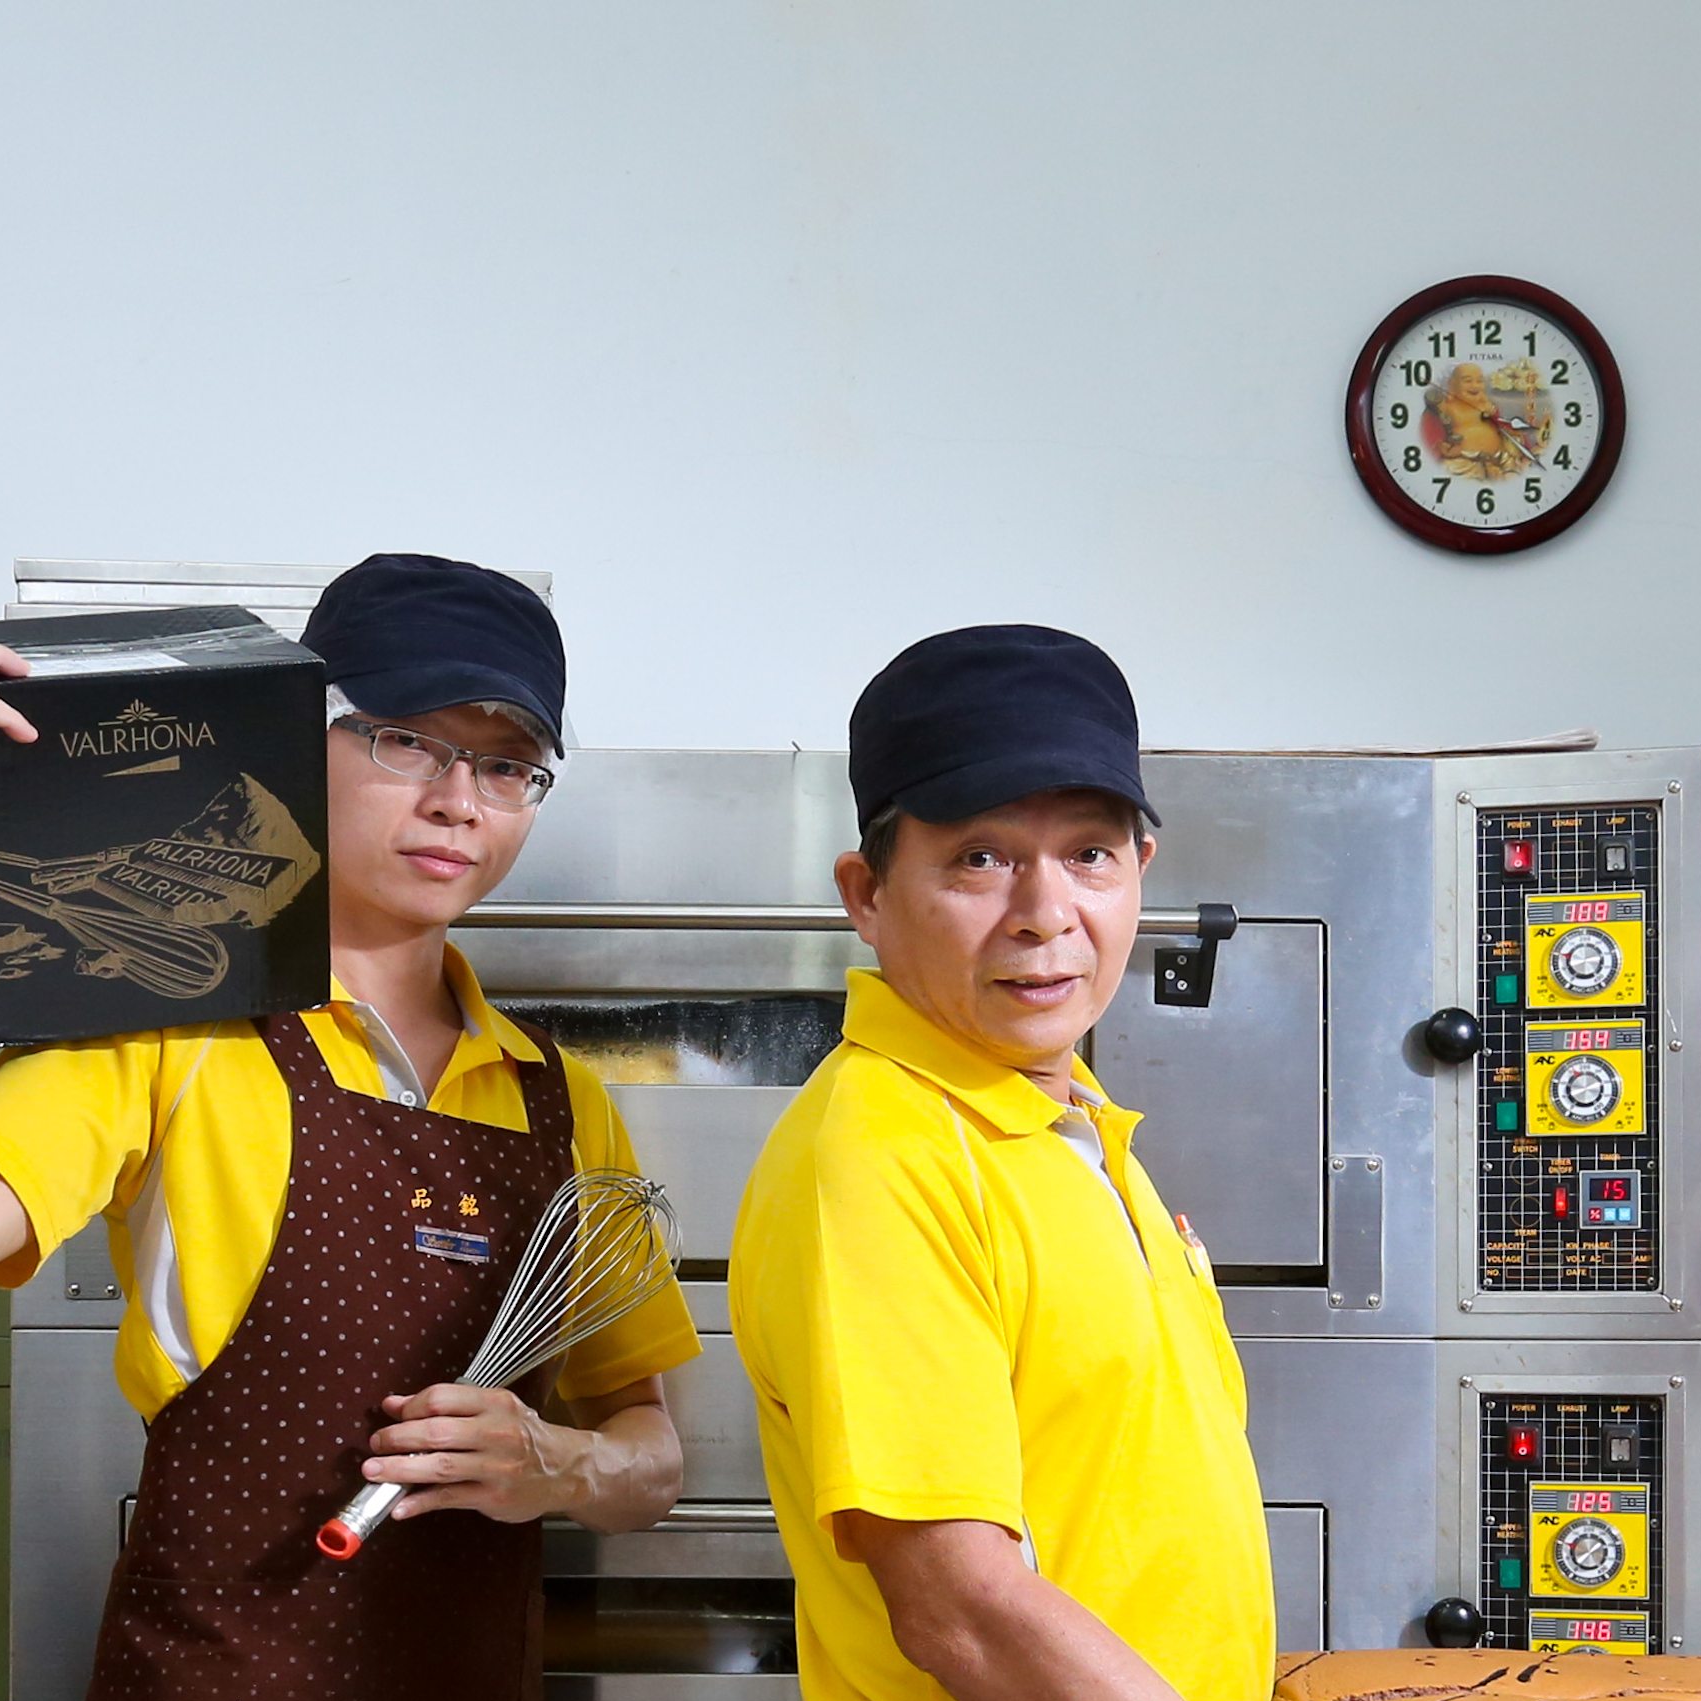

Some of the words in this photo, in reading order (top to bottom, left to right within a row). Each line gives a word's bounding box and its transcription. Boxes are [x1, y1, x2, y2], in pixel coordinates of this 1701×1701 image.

[1428, 332, 1456, 357] 11
[1470, 320, 1502, 345] 12
[1524, 332, 1536, 356] 1
[1400, 360, 1432, 386] 10
[1551, 360, 1569, 385] 2
[1390, 403, 1408, 429] 9
[1564, 402, 1581, 427] 3
[1403, 446, 1422, 472] 8
[1553, 445, 1571, 470] 4
[1432, 478, 1451, 503] 7
[1476, 489, 1495, 514] 6
[1524, 478, 1541, 503] 5
[60, 722, 215, 758] VALRHONA
[1552, 818, 1582, 827] EXHAUST
[1606, 817, 1626, 825] LAMP
[143, 841, 273, 885] VALRHONA
[112, 865, 214, 904] VALRHO
[1569, 901, 1609, 922] 109
[1534, 928, 1556, 937] ANC
[1569, 1029, 1610, 1050] 154
[1534, 1056, 1556, 1065] ANC
[1603, 1180, 1626, 1200] 15
[1487, 1242, 1525, 1250] CAPACITY
[1557, 1404, 1587, 1412] EXHAUST
[1572, 1492, 1613, 1513] 125
[1539, 1516, 1560, 1525] ANC
[1572, 1620, 1612, 1641] 146
[1537, 1643, 1559, 1653] ANC
